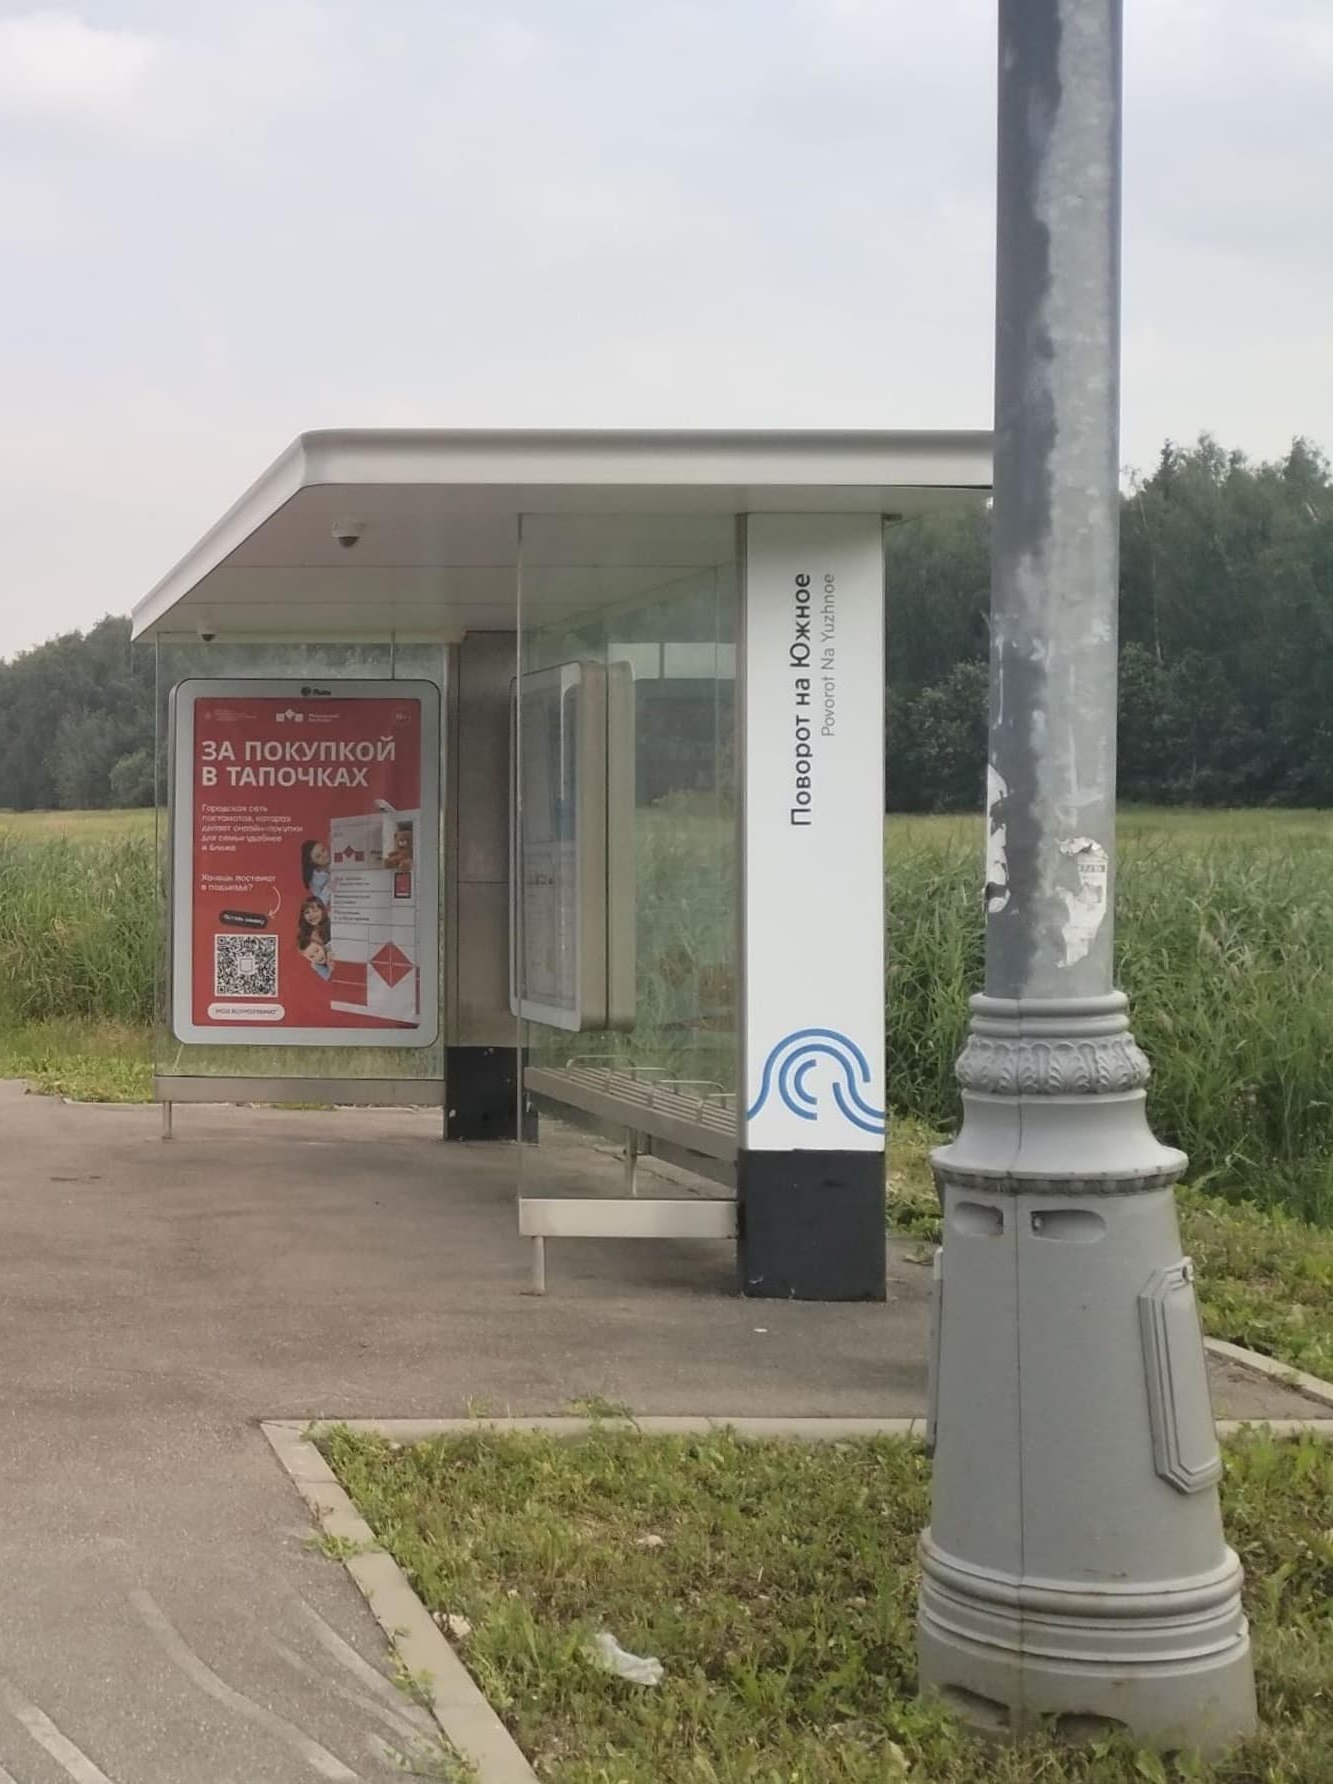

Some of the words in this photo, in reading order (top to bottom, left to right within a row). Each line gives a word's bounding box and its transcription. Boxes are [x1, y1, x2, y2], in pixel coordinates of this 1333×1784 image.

[789, 573, 811, 668] Южное
[820, 573, 836, 641] Yuzhnoe
[821, 648, 836, 670] Na
[795, 677, 811, 706] на
[821, 676, 836, 737] Povorot
[201, 740, 235, 761] ЗА
[245, 736, 396, 762] ПОКУПКОЙ
[790, 714, 813, 826] Поворот
[201, 766, 217, 786] В
[227, 766, 369, 787] ТАПОЧКАХ
